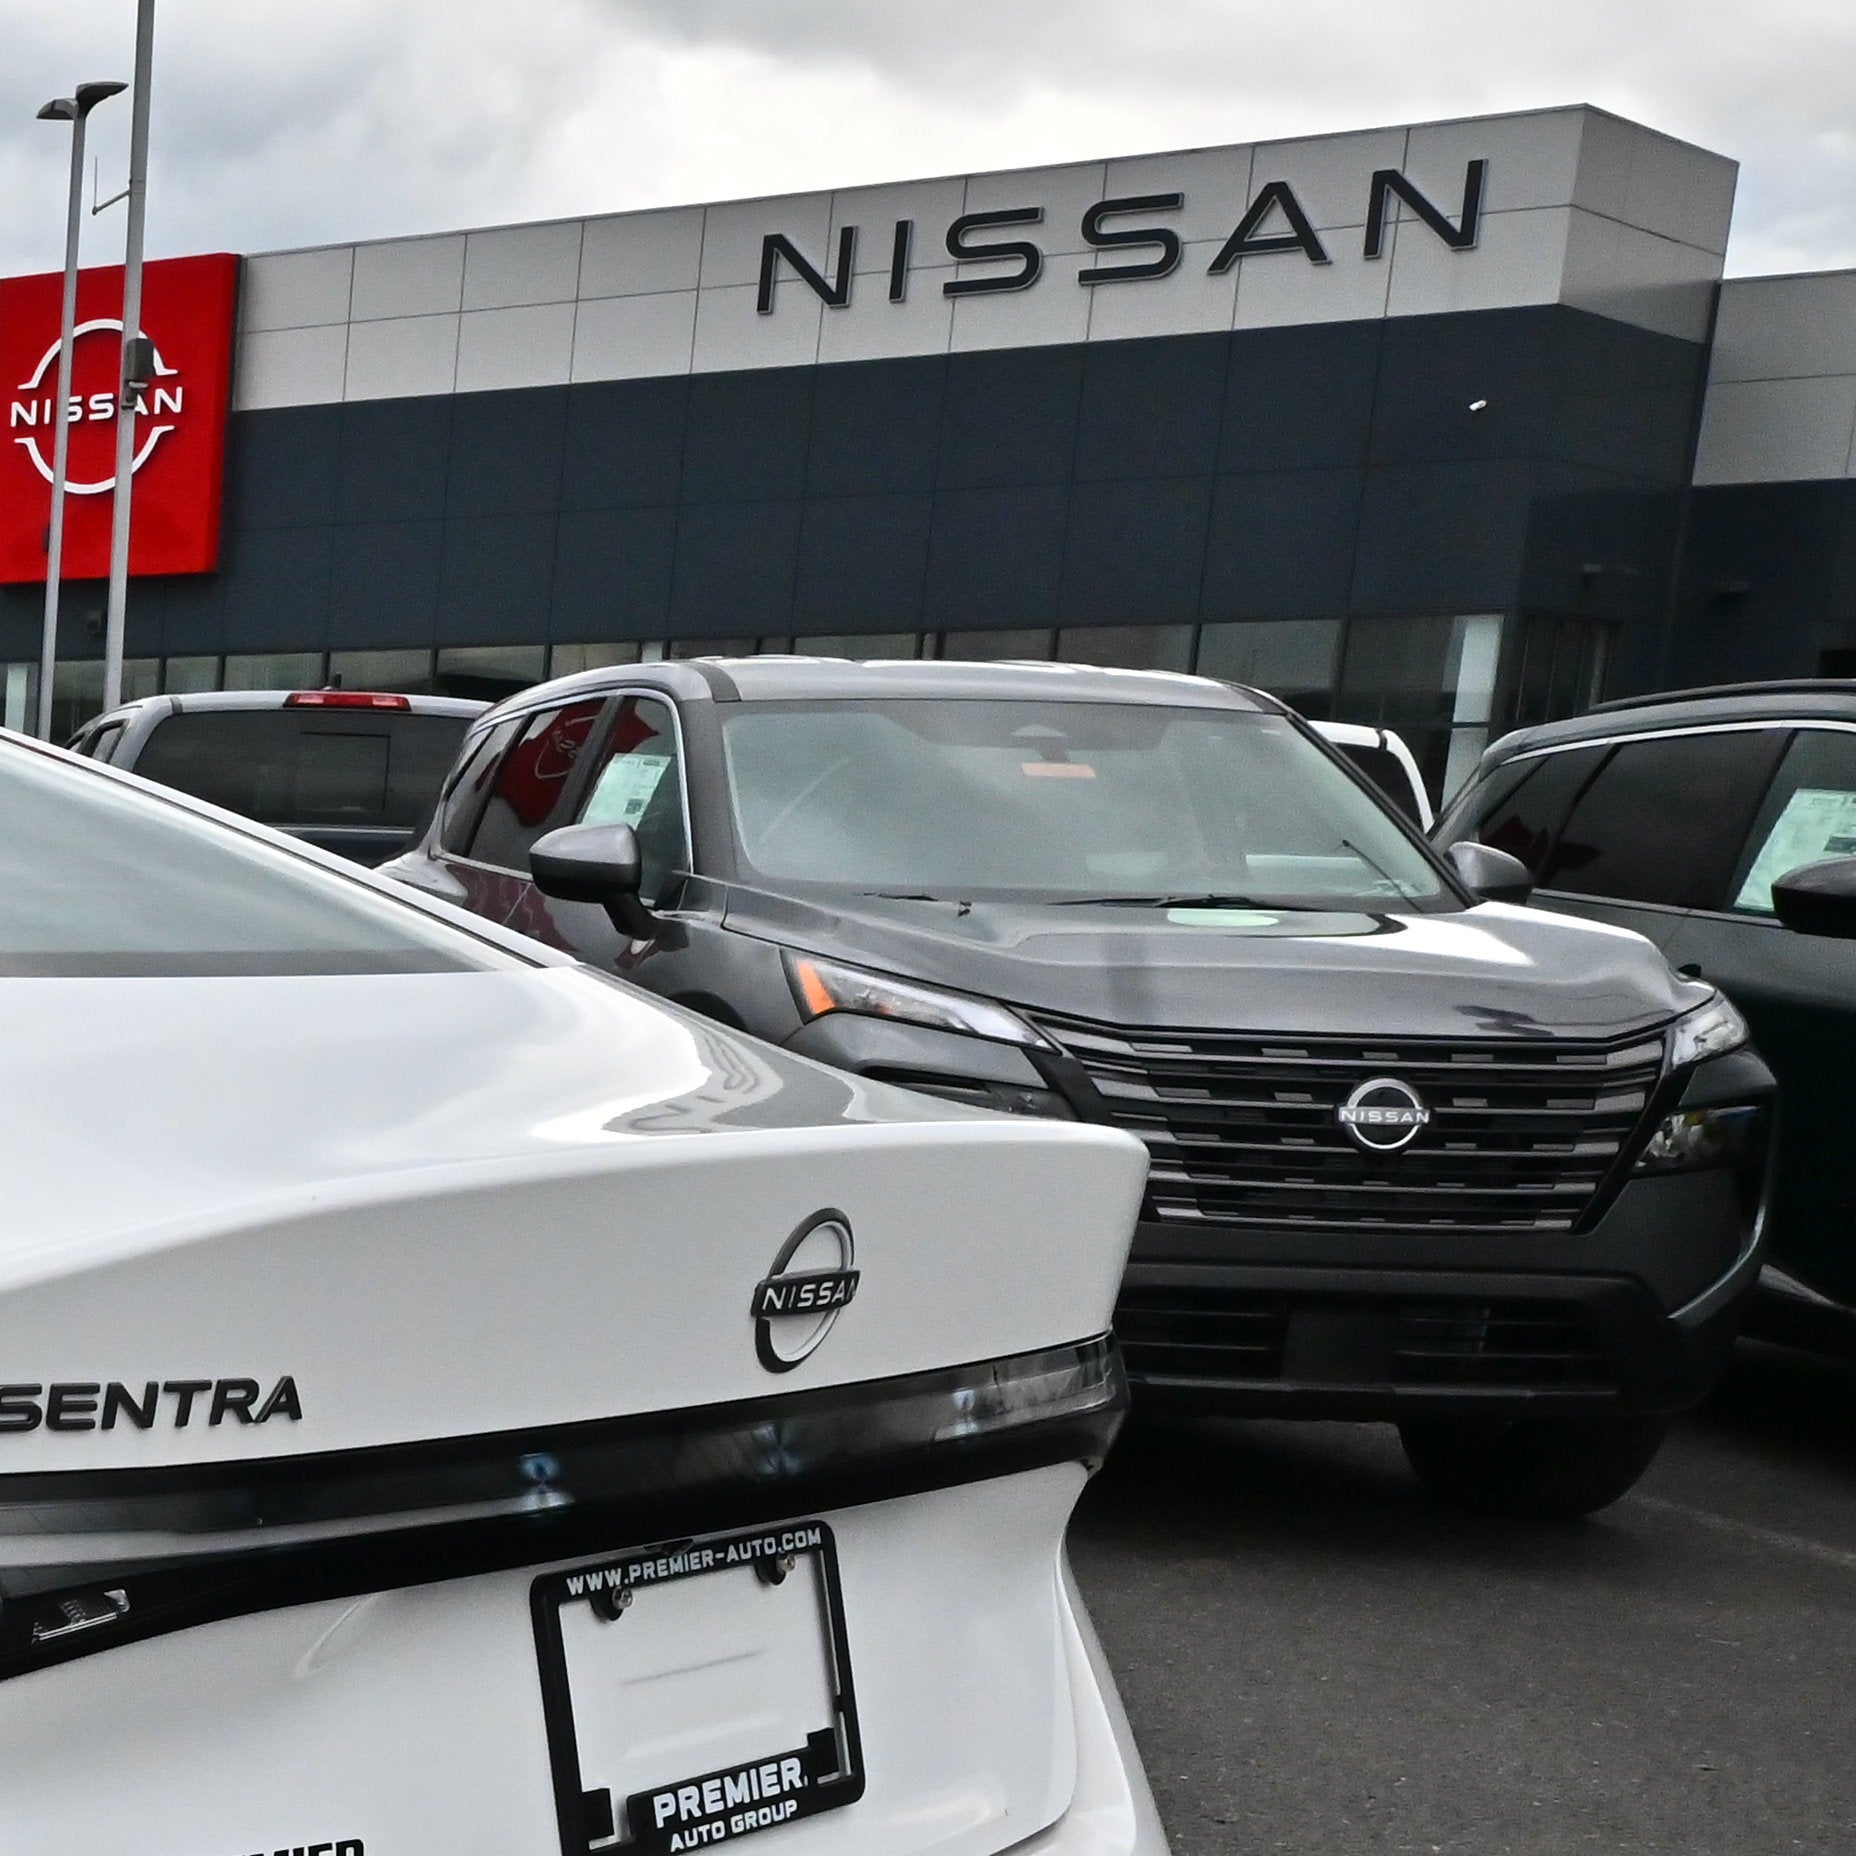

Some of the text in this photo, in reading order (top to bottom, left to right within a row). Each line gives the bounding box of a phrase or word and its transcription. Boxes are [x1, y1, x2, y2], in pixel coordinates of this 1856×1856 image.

[756, 158, 1488, 316] NISSAN
[1341, 1110, 1429, 1124] NISSAN
[762, 1276, 858, 1311] NISSAN
[566, 1527, 822, 1596] WWW.PREMIER-AUTO.COM
[670, 1799, 799, 1853] AUTO GROUP
